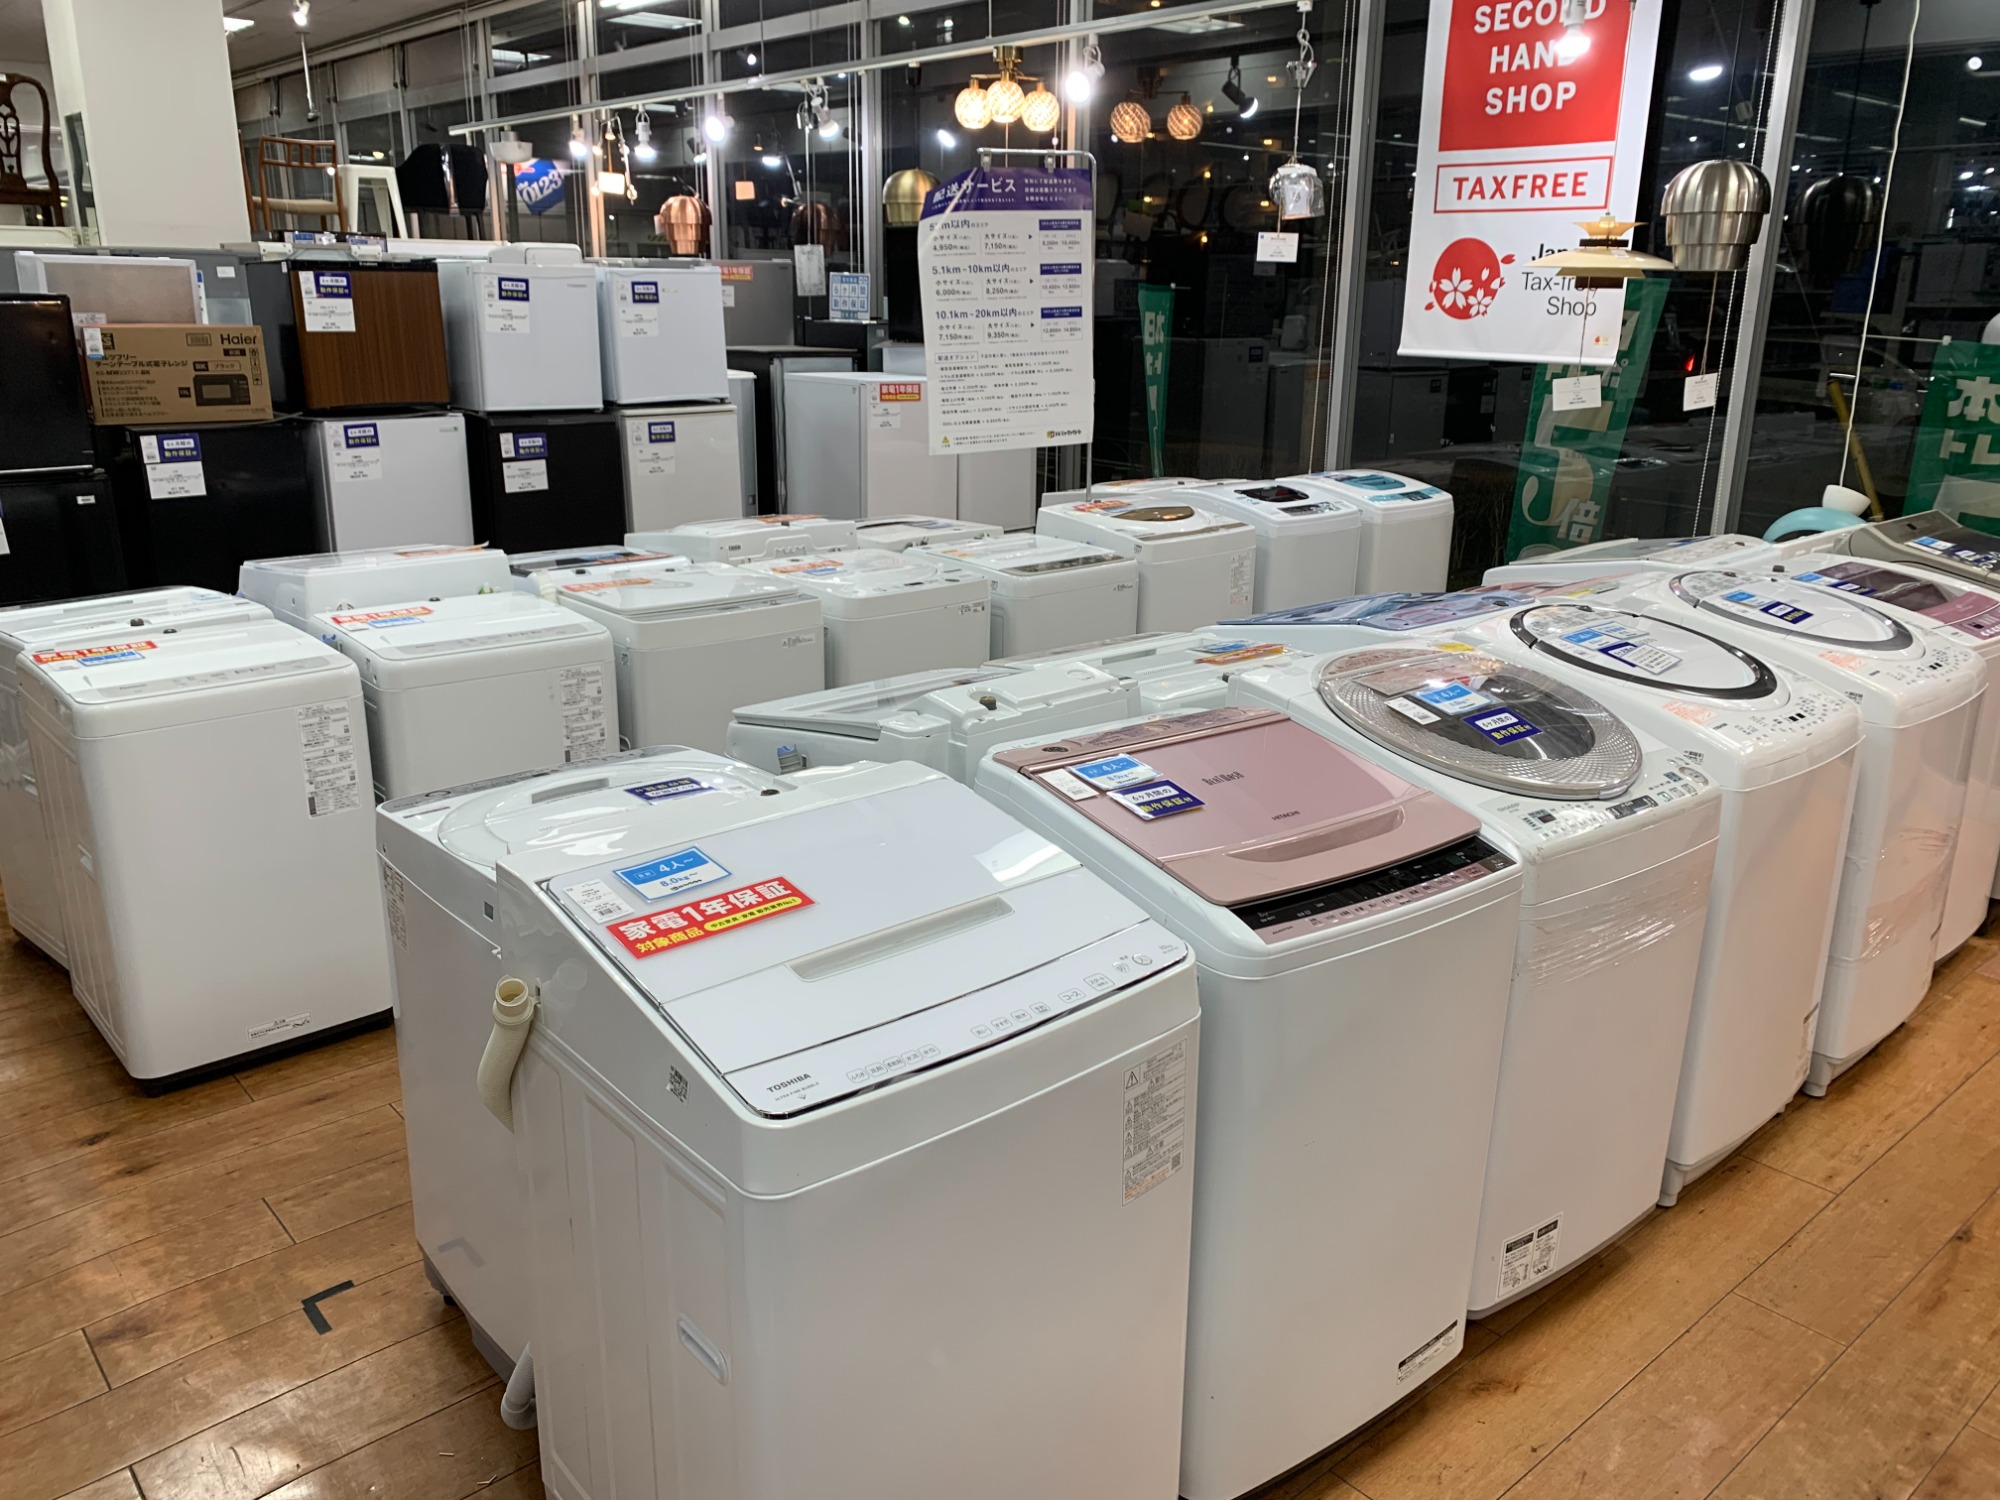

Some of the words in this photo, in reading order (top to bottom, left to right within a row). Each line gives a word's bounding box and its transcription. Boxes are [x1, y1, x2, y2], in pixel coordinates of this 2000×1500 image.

[1484, 81, 1577, 116] SHOP
[1453, 171, 1589, 200] TAXFREE
[1521, 271, 1598, 292] Tax-fr
[1545, 296, 1597, 319] Shop
[220, 333, 257, 345] Haier
[1132, 788, 1172, 801] 6ヶ月間の
[1271, 810, 1300, 821] HITACHI
[618, 880, 792, 941] 家電1年保証
[635, 927, 704, 953] 対象商品
[1062, 991, 1082, 1001] コース
[766, 1073, 812, 1093] TOSHIBA
